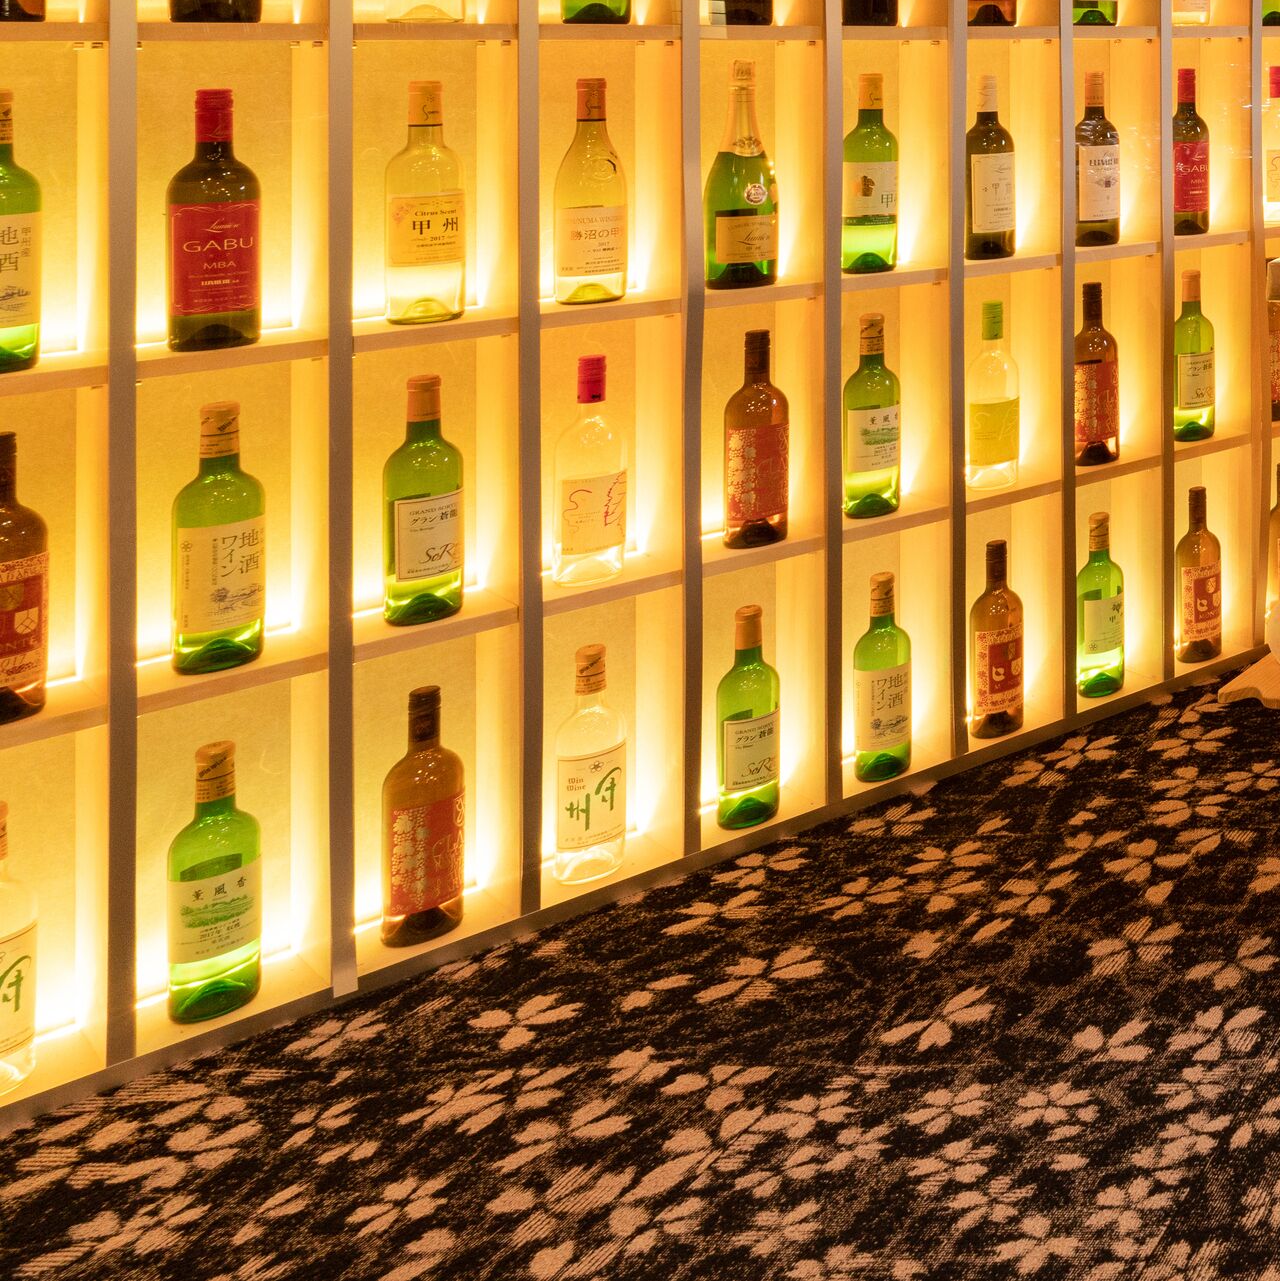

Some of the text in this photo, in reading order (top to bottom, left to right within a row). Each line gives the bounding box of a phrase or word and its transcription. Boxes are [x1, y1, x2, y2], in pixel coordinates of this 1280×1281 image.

[412, 217, 459, 235] 甲州
[183, 236, 255, 253] GABU
[202, 261, 237, 270] MBA
[220, 534, 239, 581] ワイン
[240, 527, 260, 575] 地酒
[876, 678, 888, 711] ワイン
[888, 676, 904, 710] 地酒
[192, 875, 247, 902] 薫風香
